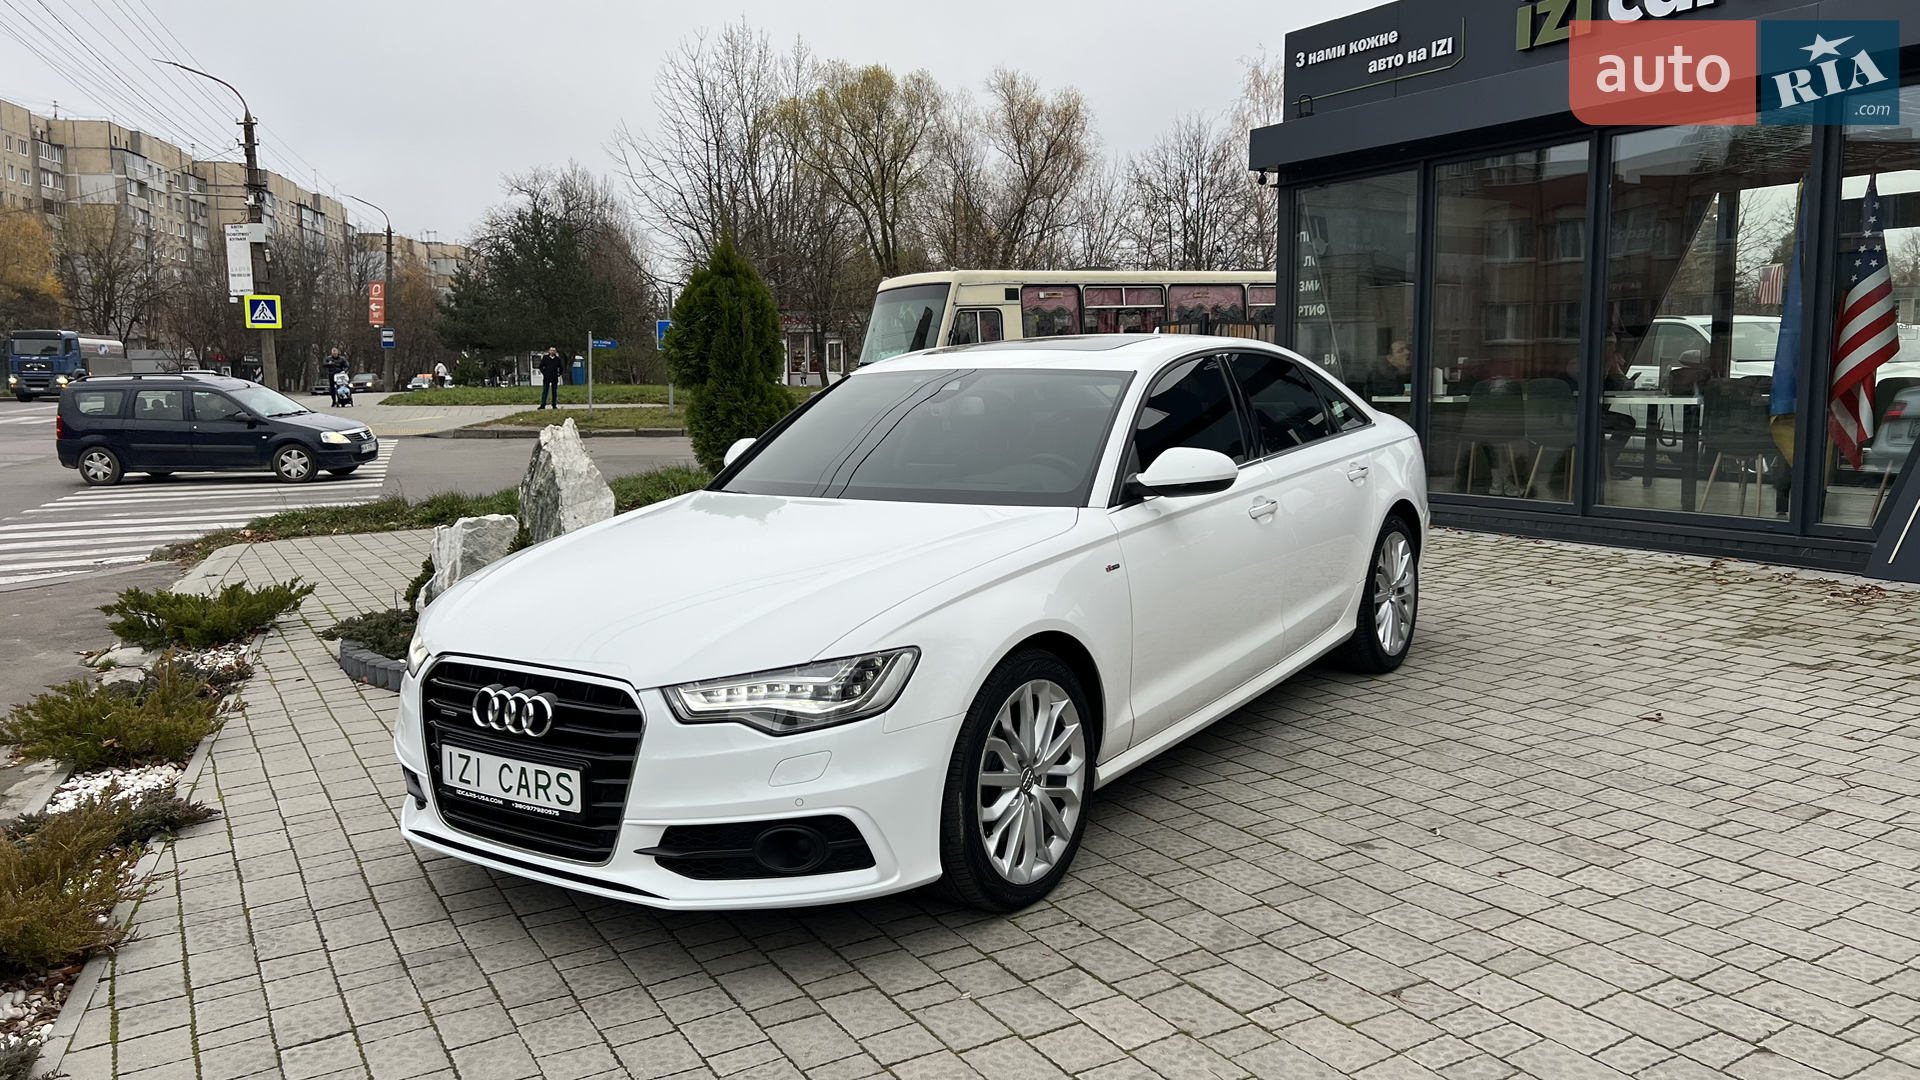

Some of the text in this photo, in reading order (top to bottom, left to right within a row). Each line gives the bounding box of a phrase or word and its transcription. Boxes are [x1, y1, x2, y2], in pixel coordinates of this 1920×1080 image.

[1295, 30, 1398, 68] З нами кожне
[1367, 36, 1453, 74] авто на IZI
[449, 751, 574, 806] IZI CARS
